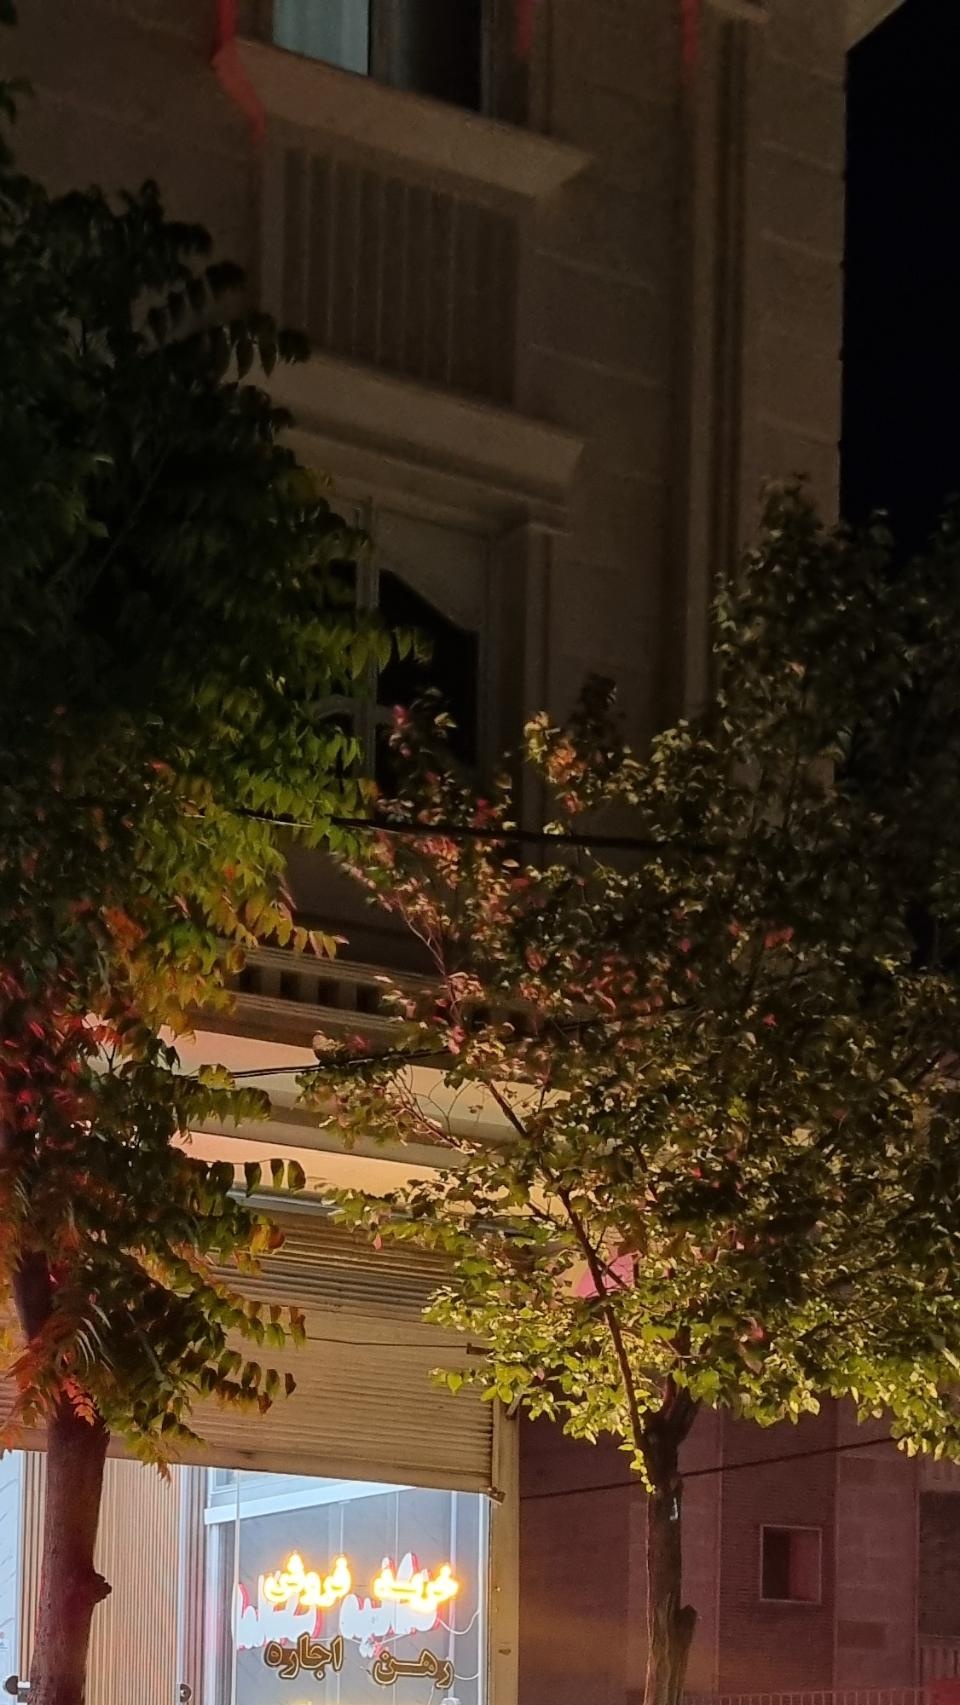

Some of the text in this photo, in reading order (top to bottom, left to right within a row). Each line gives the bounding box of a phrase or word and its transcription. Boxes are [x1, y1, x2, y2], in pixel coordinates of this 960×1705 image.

[263, 1551, 460, 1612] خرید فروش
[263, 1633, 454, 1690] رهن اجاره
